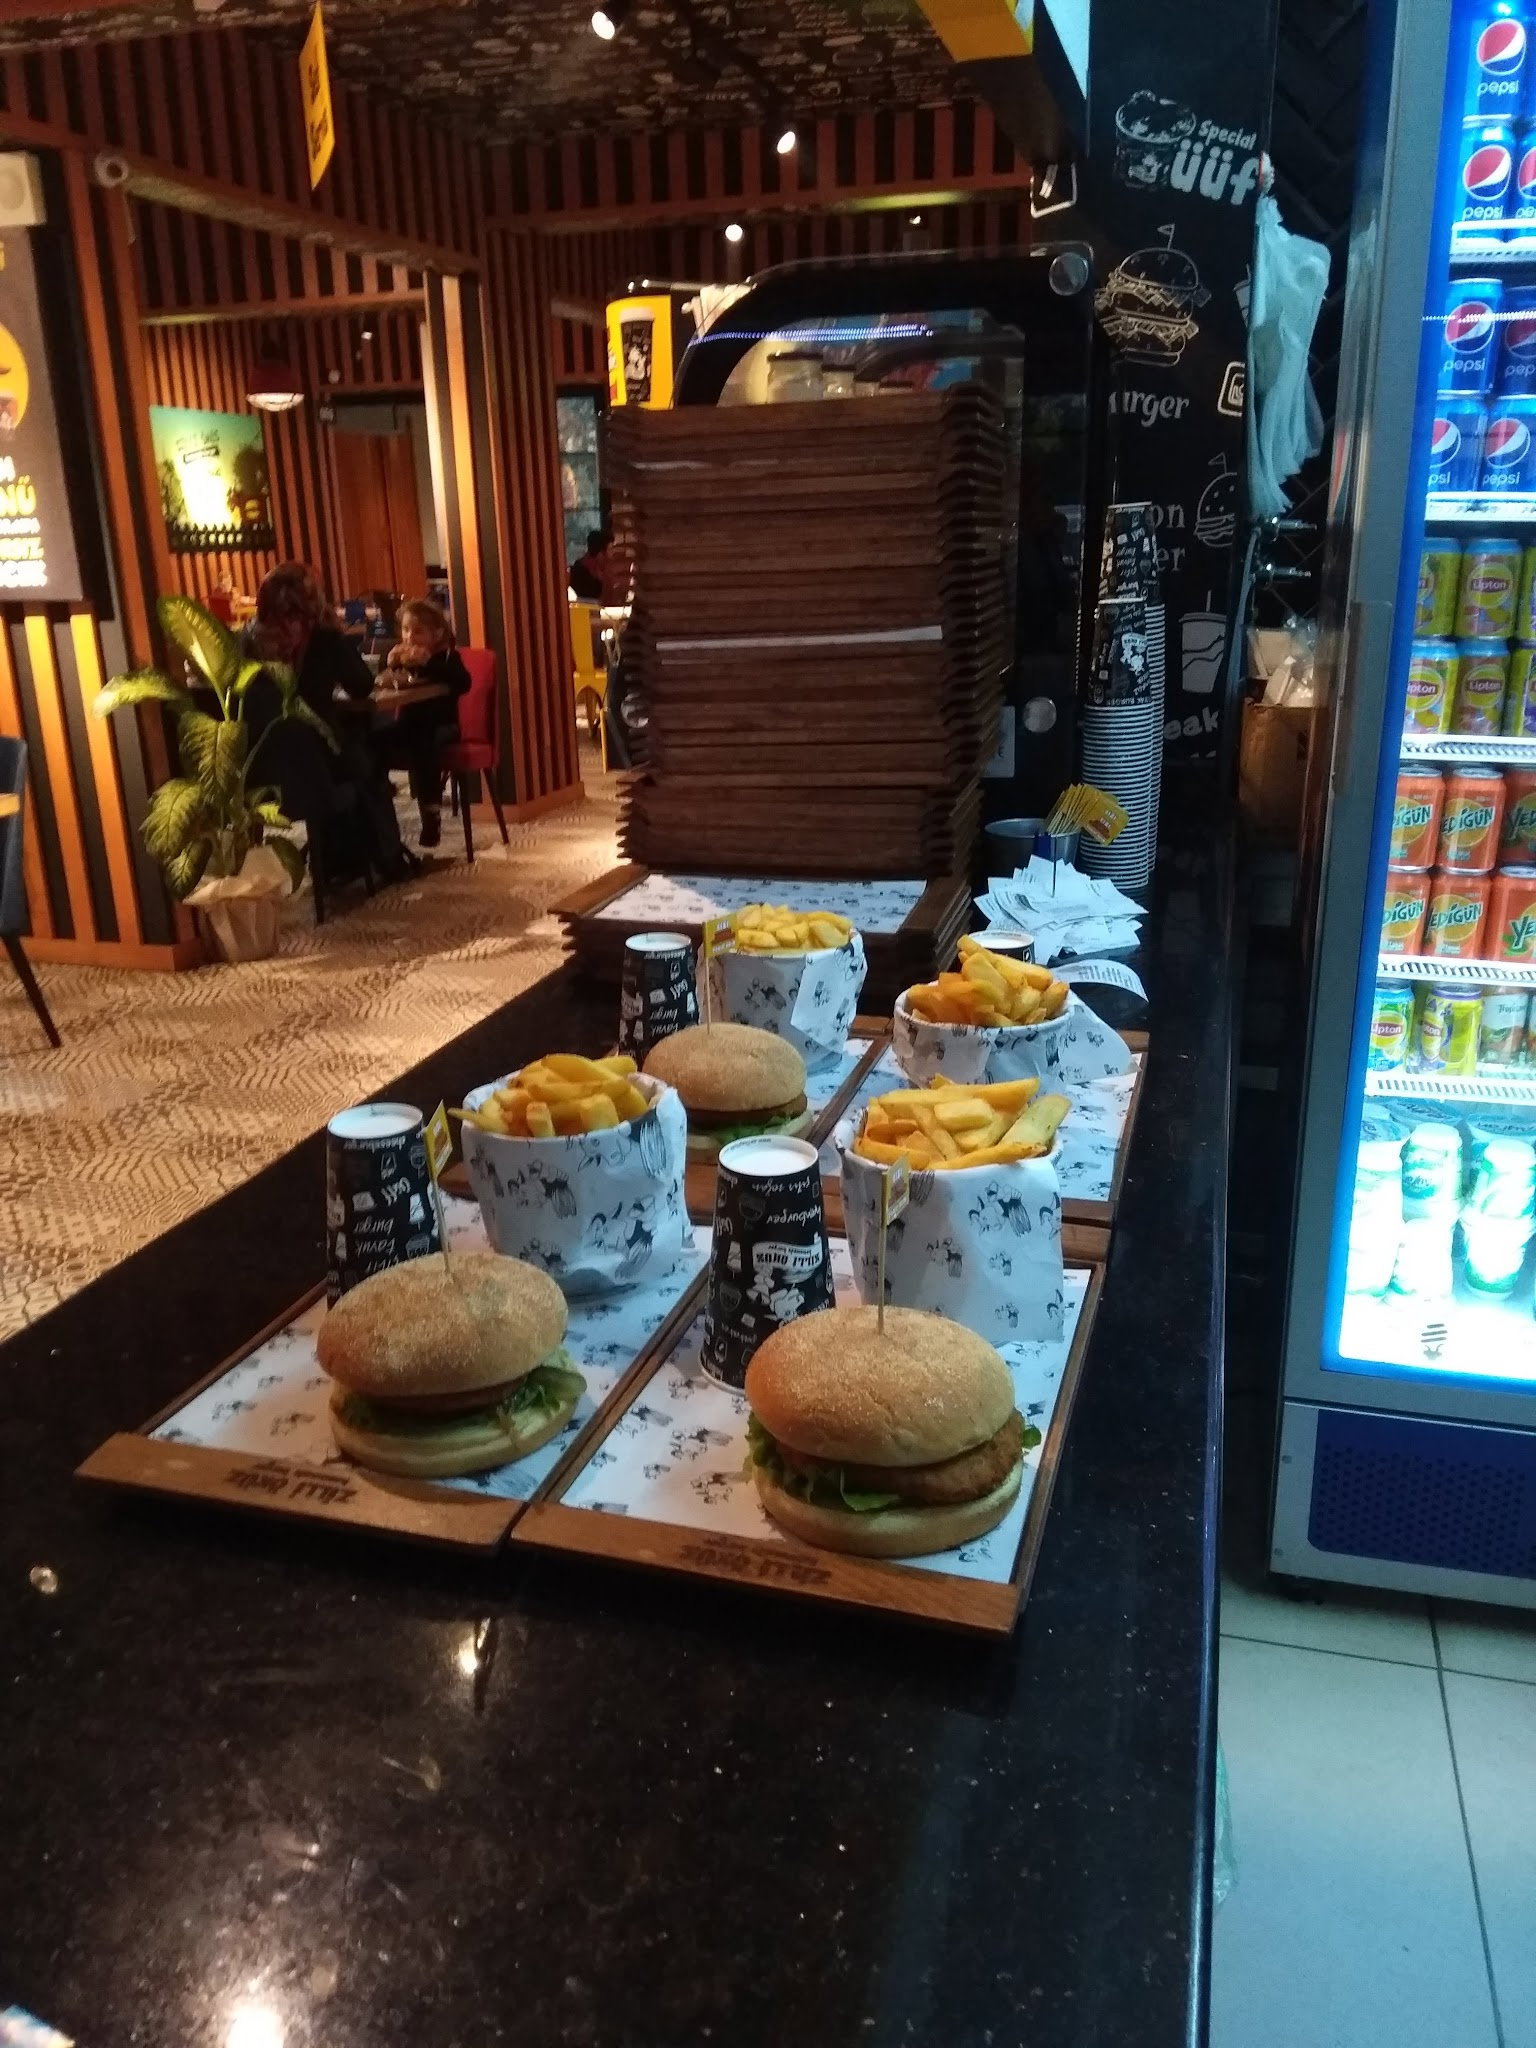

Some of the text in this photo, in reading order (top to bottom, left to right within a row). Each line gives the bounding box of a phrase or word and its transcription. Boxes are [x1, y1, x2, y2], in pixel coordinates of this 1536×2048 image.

[1477, 80, 1519, 97] pepsi
[1199, 118, 1257, 150] Special
[1462, 205, 1504, 221] pepsi
[1444, 358, 1486, 373] pepsi
[1482, 472, 1521, 486] pepsi
[1473, 579, 1507, 592] Lipton
[1468, 681, 1501, 693] Lipton
[355, 1217, 394, 1234] burger
[355, 1238, 395, 1256] tavuk
